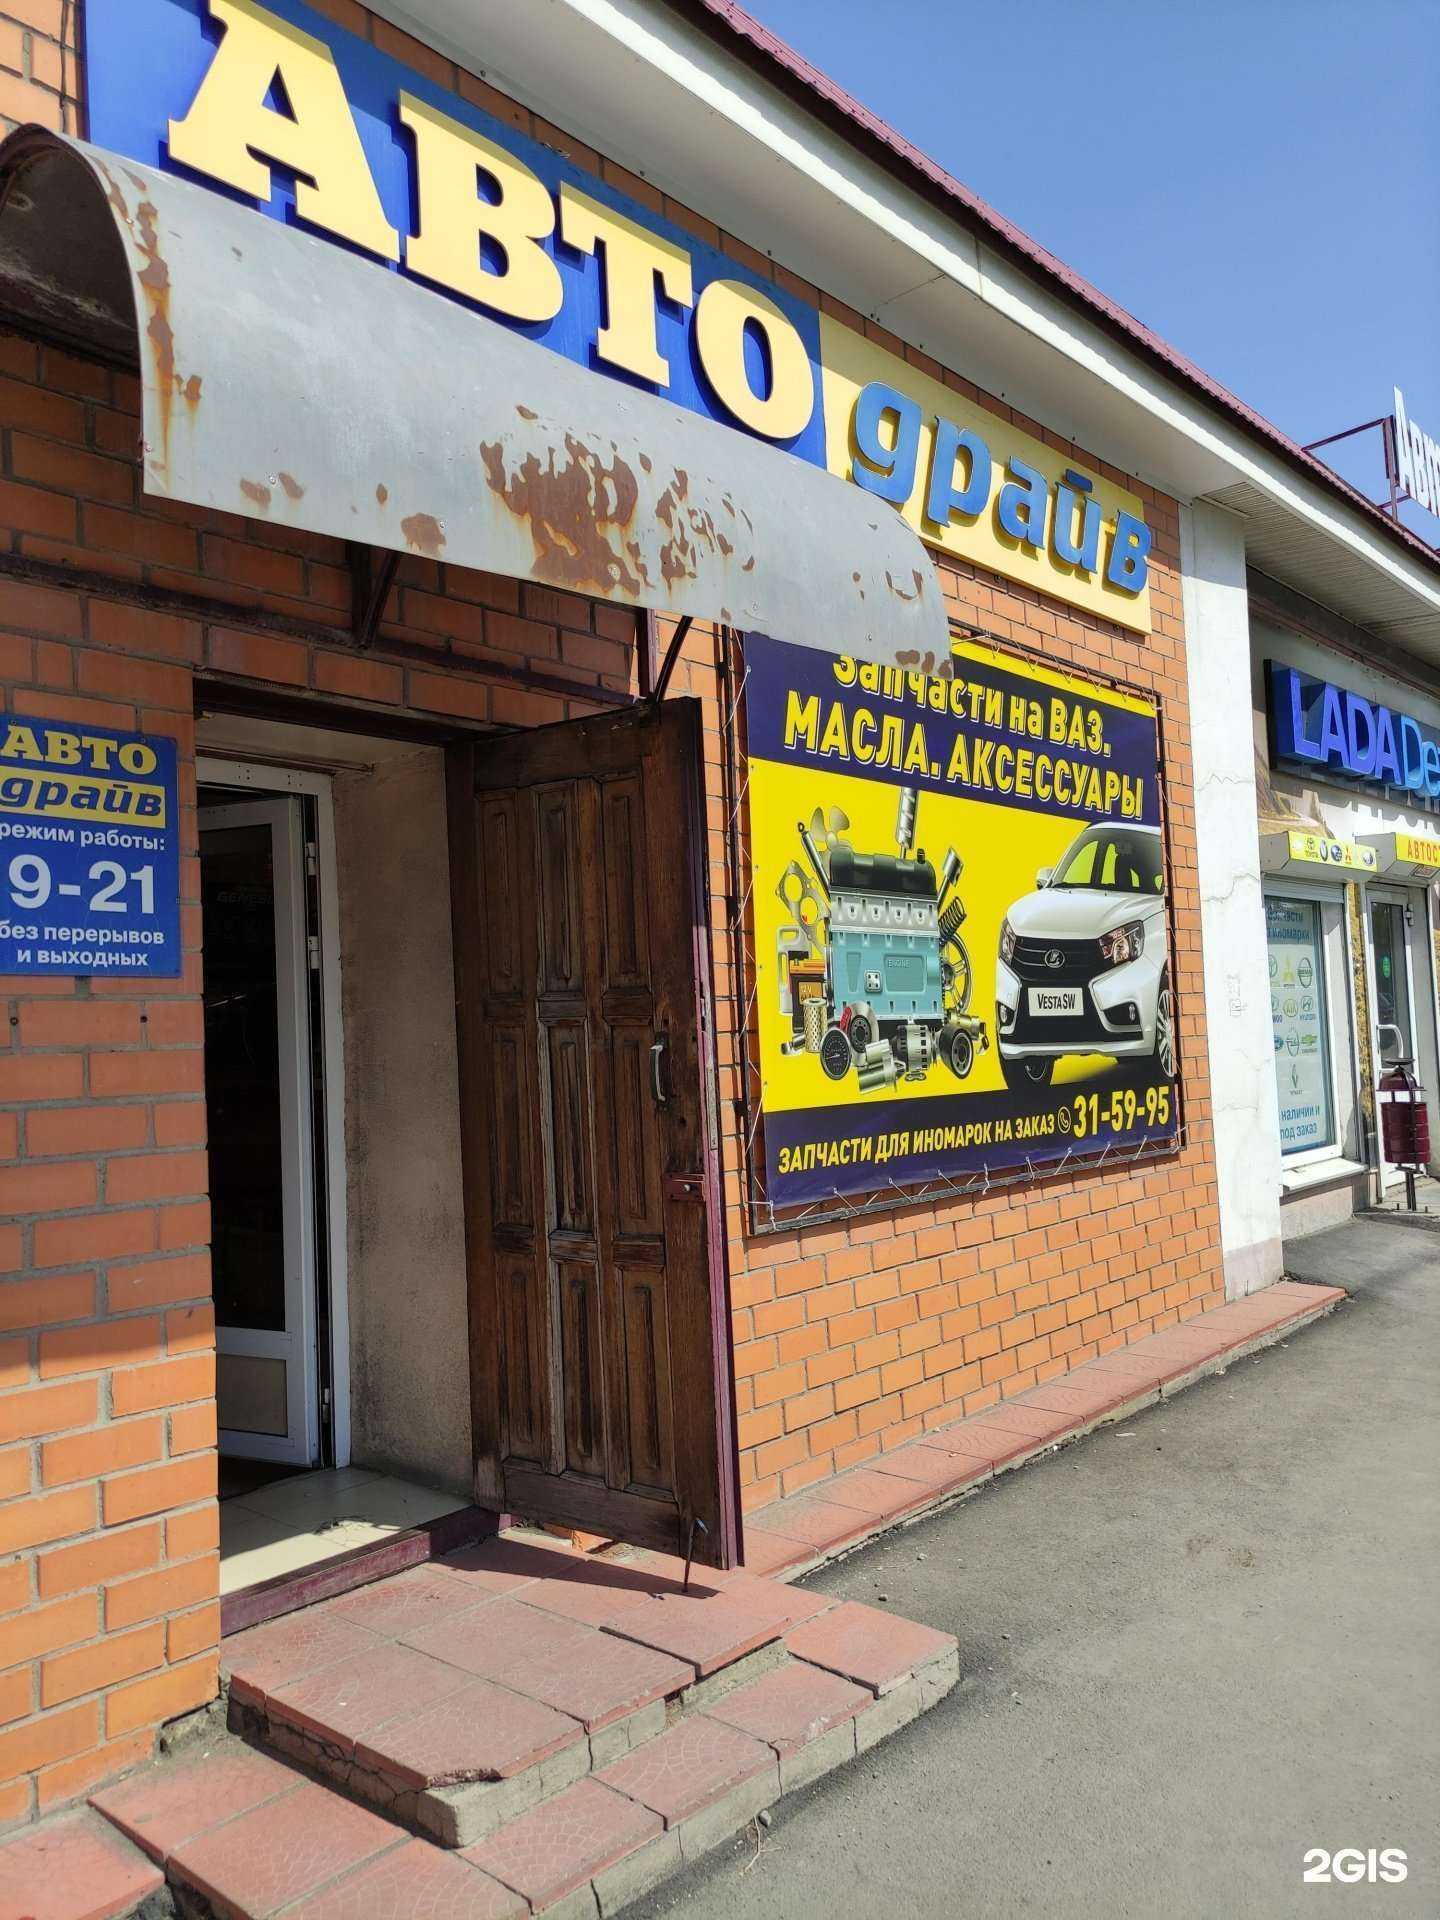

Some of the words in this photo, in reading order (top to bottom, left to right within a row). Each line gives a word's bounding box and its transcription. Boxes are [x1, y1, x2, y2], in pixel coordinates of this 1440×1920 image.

[851, 381, 1151, 593] драйв
[1009, 695, 1043, 740] на
[1049, 697, 1112, 758] ВАЗ.
[783, 689, 941, 778] МАСЛА.
[946, 736, 1143, 820] АКСЕССУАРЫ
[0, 776, 162, 817] драйв
[0, 822, 75, 843] режим
[80, 829, 166, 850] работы:
[1407, 839, 1440, 864] АВТОС
[8, 854, 155, 914] 9-21
[0, 920, 39, 940] без
[43, 928, 165, 945] перерывов
[16, 950, 32, 963] и
[37, 950, 149, 967] выходных
[1063, 993, 1076, 1009] SW
[1281, 1106, 1314, 1121] наличии
[778, 1136, 872, 1174] ЗАПЧАСТИ
[874, 1134, 910, 1164] ДЛЯ
[912, 1121, 992, 1154] ИНОМАРОК
[995, 1123, 1013, 1143] НА
[1015, 1114, 1056, 1139] ЗАКАЗ
[1072, 1085, 1170, 1139] 31-59-95
[1280, 1127, 1295, 1141] под
[1296, 1122, 1317, 1137] заказ
